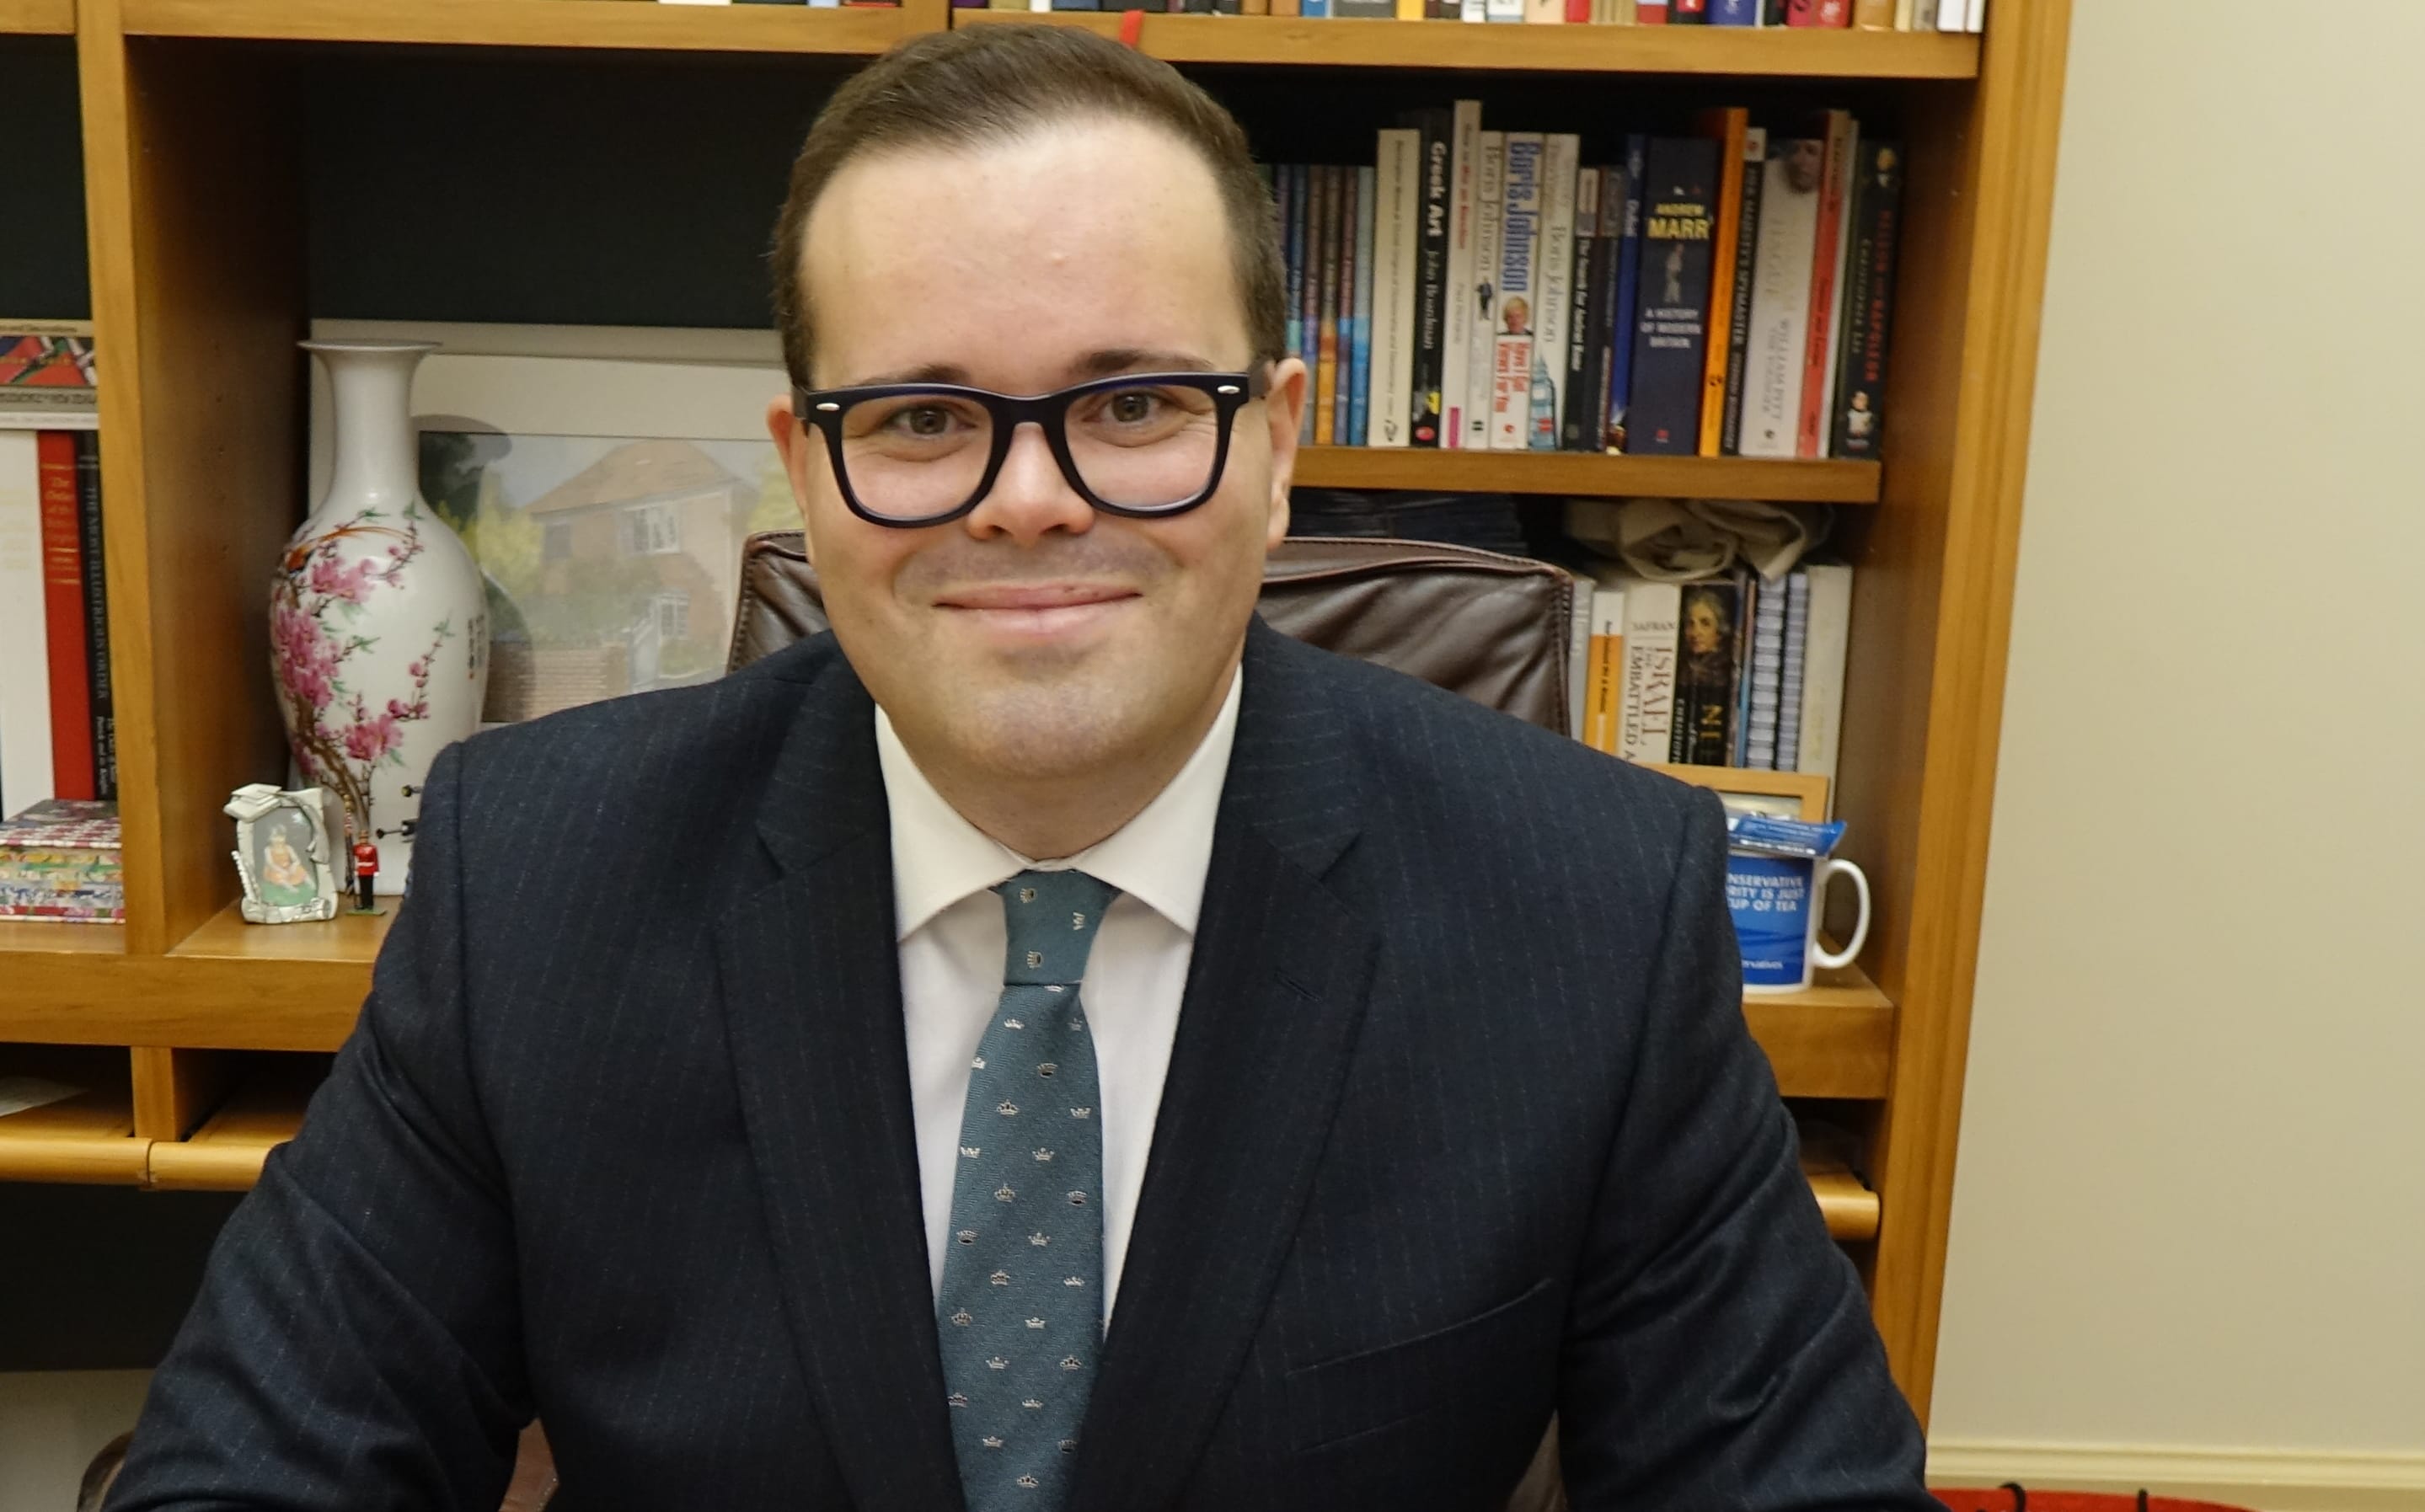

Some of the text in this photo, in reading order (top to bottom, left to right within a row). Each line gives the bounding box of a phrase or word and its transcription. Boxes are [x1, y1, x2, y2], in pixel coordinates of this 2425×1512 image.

[1427, 141, 1447, 237] Greek Art
[1477, 146, 1499, 272] Boris Johnson
[1502, 142, 1542, 291] Boris Johnson
[1646, 216, 1711, 241] MARR
[1541, 225, 1568, 343] Boris Johnson
[1644, 307, 1655, 319] A
[1732, 269, 1750, 346] SPYMASTER
[1496, 341, 1512, 373] Views
[1639, 321, 1654, 334] OF
[1775, 318, 1791, 385] WILLIAM
[1770, 387, 1786, 420] PITT
[1625, 645, 1645, 746] EMBATTLED
[1641, 647, 1674, 745] ISRAEL
[1752, 899, 1772, 911] OF
[1775, 900, 1797, 912] TEA
[1761, 888, 1775, 900] IS
